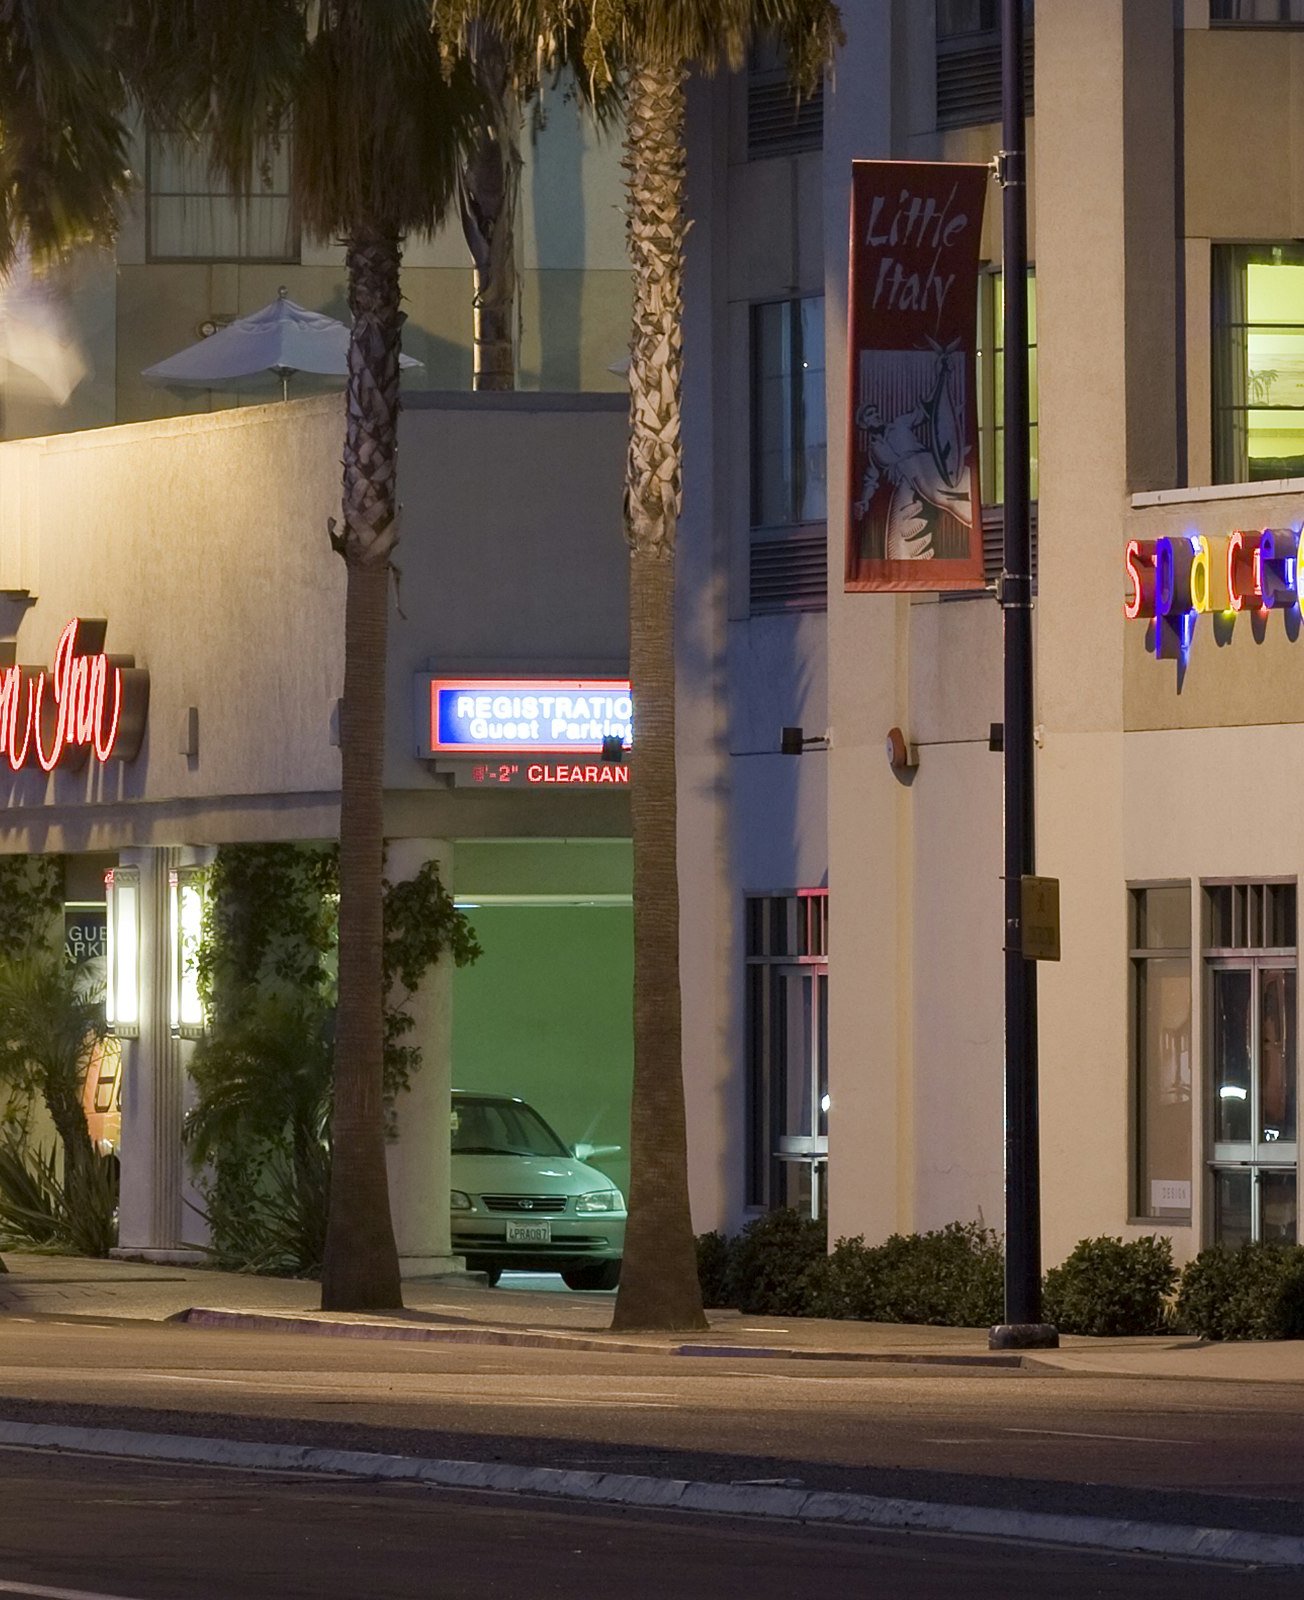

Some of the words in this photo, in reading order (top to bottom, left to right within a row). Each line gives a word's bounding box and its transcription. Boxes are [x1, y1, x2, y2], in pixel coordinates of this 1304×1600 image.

[865, 181, 968, 249] Little
[871, 248, 956, 334] Italy
[1125, 529, 1295, 660] space
[35, 616, 122, 772] Inn
[457, 696, 633, 720] REGISTRATIO
[469, 718, 540, 740] Guest
[527, 764, 630, 783] CLEARAN
[68, 926, 107, 941] GUE
[65, 941, 107, 957] ARKI
